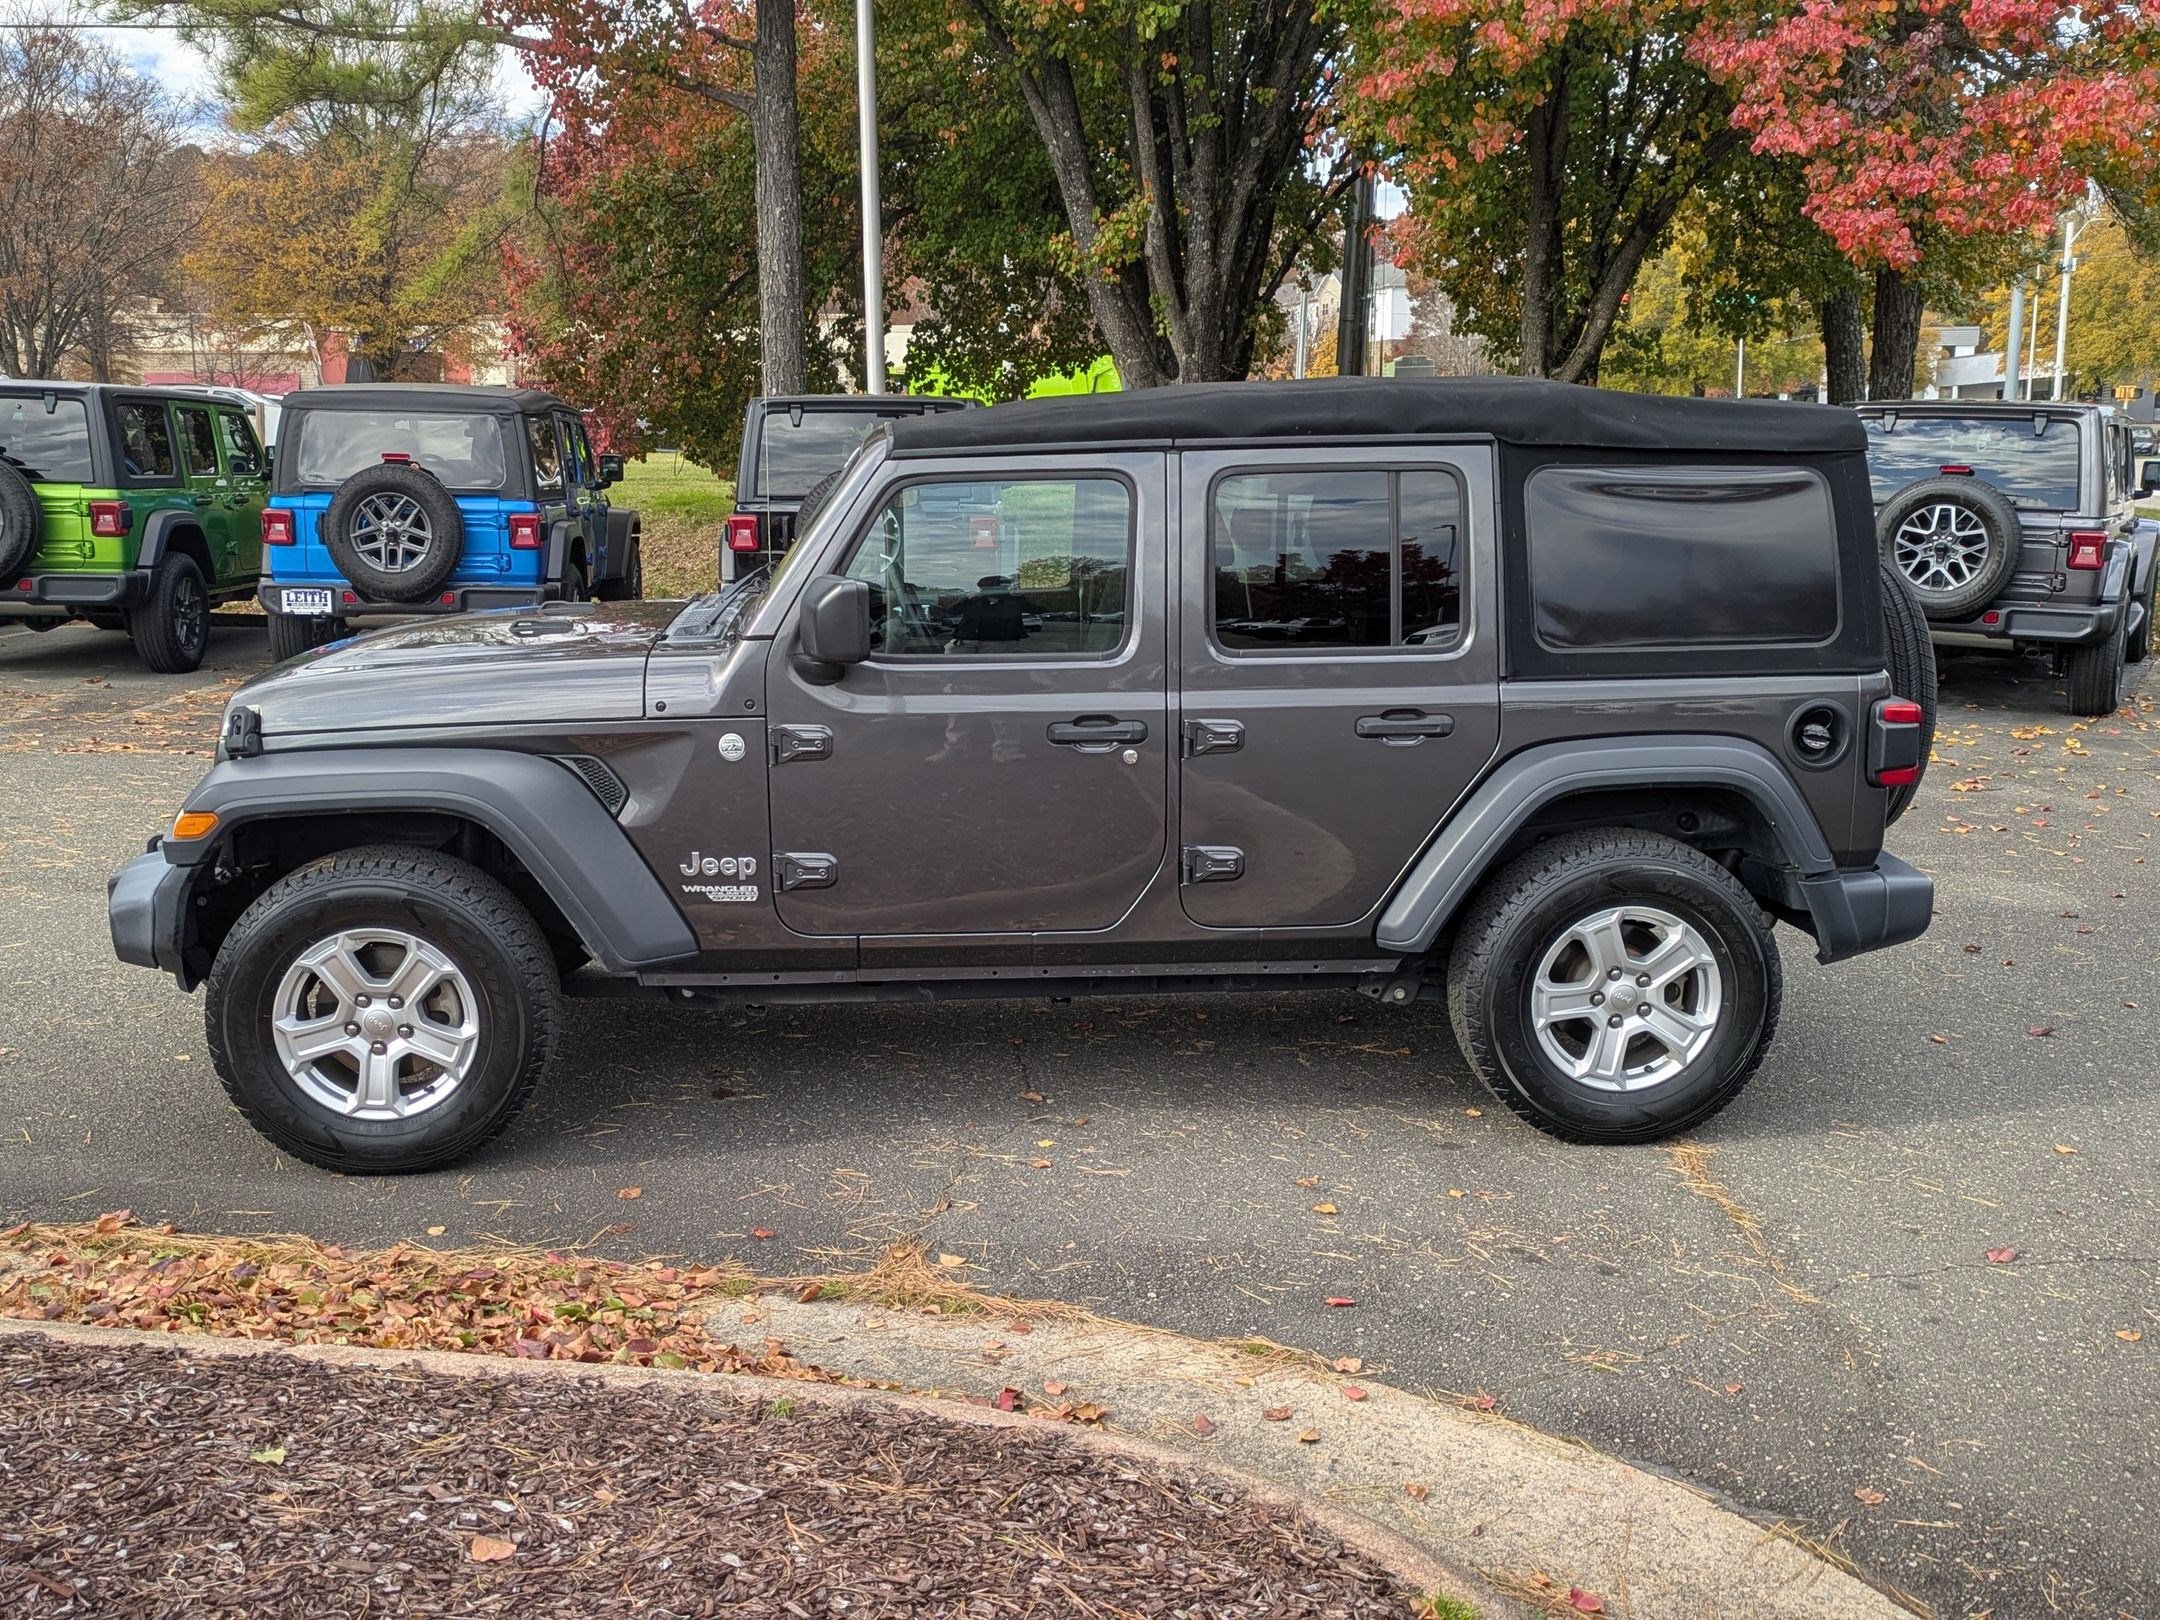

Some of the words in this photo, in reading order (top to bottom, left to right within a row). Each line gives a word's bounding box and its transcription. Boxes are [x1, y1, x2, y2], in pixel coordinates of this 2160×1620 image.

[286, 591, 328, 602] LEITH
[680, 852, 757, 880] Jeep
[681, 885, 758, 893] WRANGLER
[369, 1016, 389, 1031] Jeep
